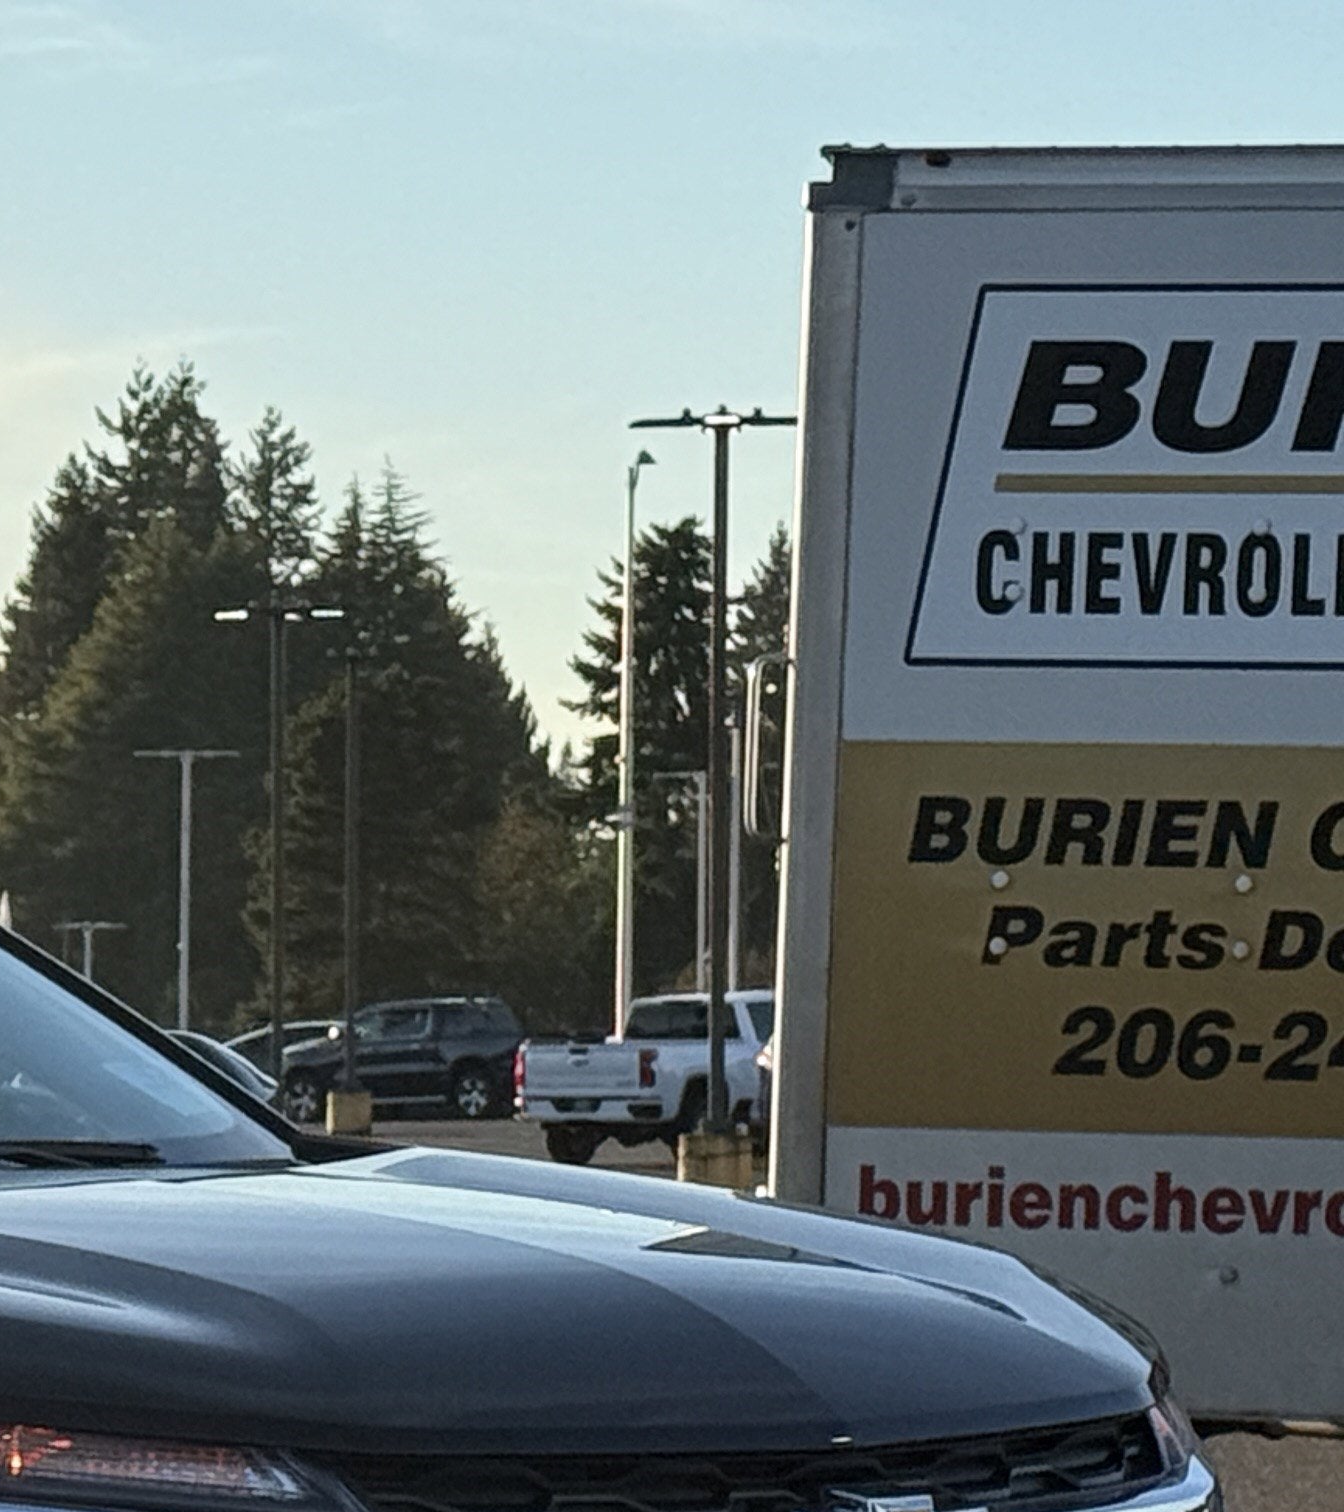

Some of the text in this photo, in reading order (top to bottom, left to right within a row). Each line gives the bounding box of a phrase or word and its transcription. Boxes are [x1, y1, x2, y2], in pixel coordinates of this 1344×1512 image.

[975, 530, 1344, 618] CHEVROL
[907, 795, 1279, 869] BURIEN
[980, 905, 1228, 970] Parts
